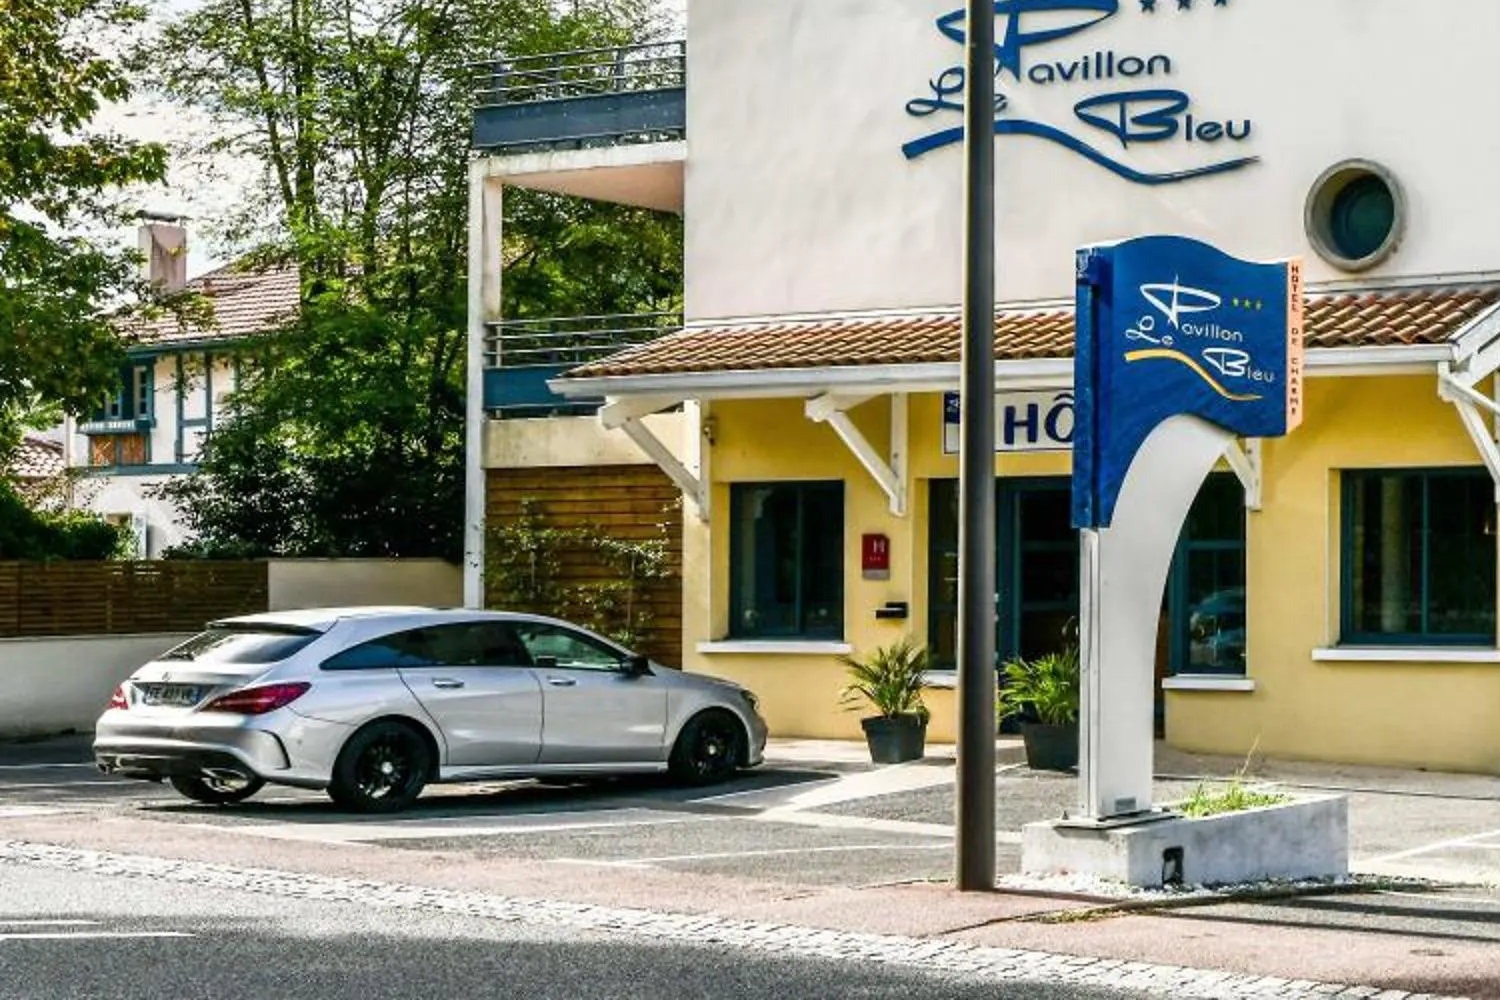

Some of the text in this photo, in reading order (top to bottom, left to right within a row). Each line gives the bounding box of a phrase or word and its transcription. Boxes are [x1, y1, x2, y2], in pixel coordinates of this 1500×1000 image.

[1074, 89, 1251, 149] Bleu
[1125, 273, 1243, 346] Le Pavillon
[1202, 347, 1275, 382] Bleu
